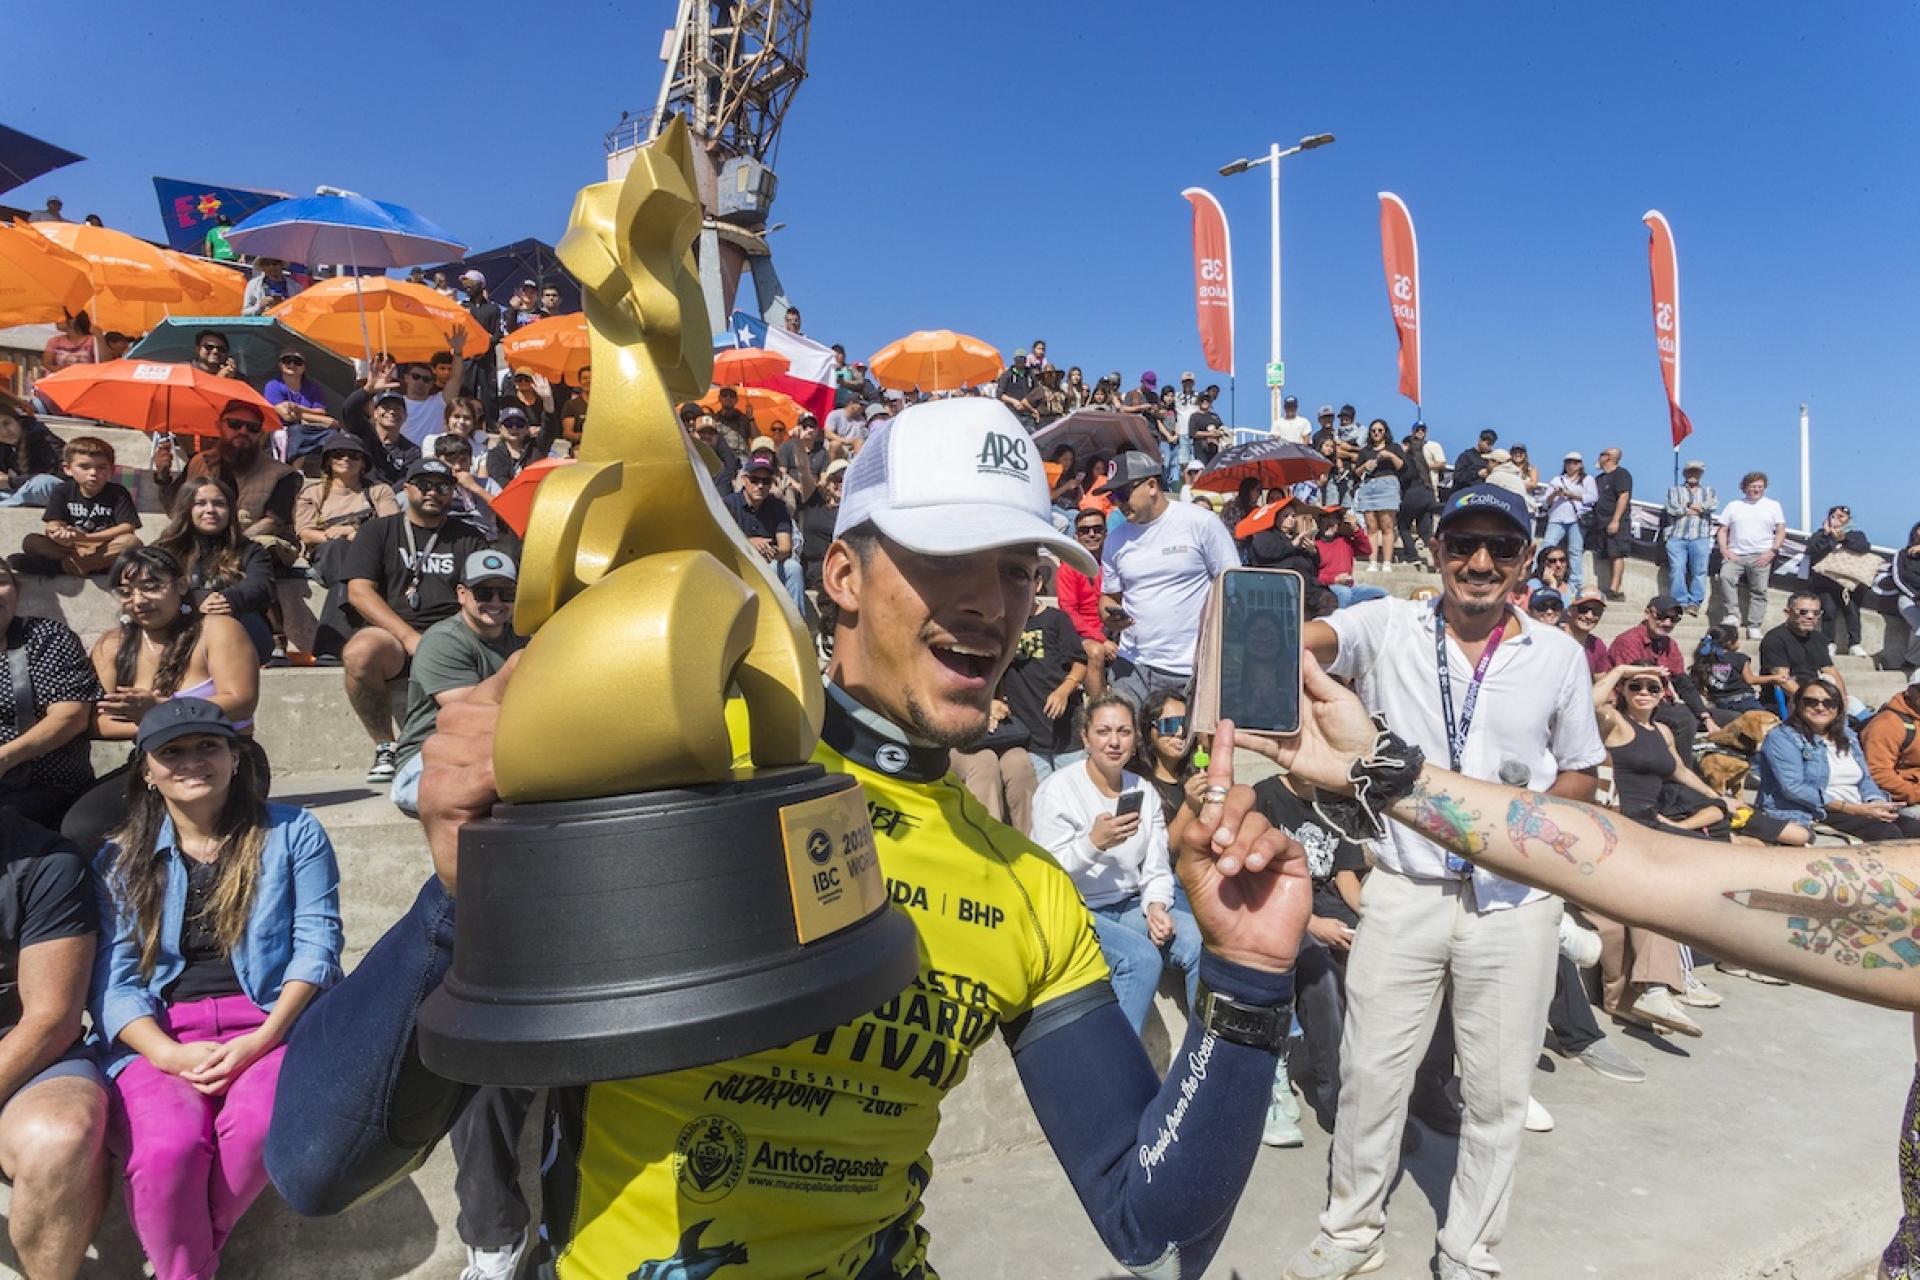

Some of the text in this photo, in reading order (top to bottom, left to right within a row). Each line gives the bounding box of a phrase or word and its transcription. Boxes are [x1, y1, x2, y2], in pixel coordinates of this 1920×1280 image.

[976, 431, 1028, 470] ARS
[812, 866, 840, 893] IBC
[959, 897, 1004, 929] BHP
[772, 1066, 879, 1096] DESAFIO
[752, 1141, 888, 1182] Antofagasta
